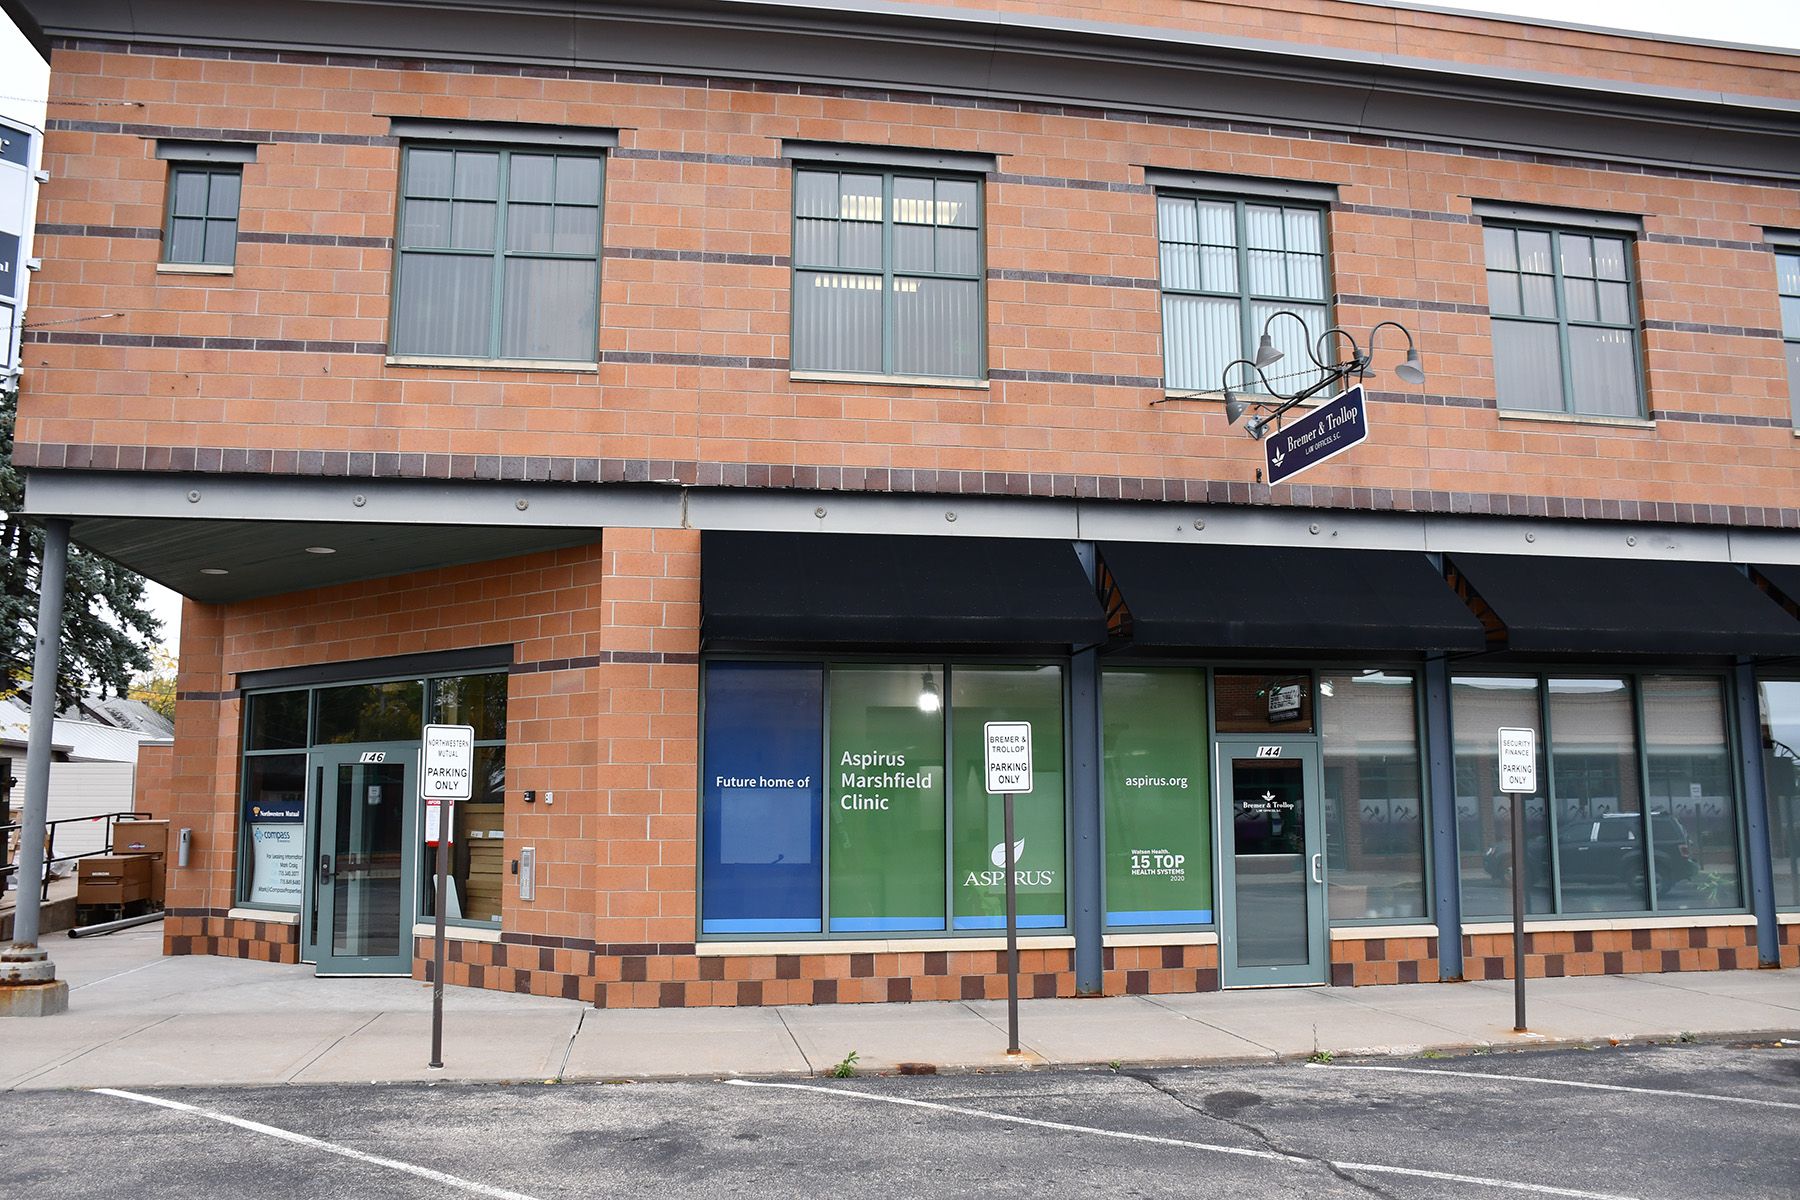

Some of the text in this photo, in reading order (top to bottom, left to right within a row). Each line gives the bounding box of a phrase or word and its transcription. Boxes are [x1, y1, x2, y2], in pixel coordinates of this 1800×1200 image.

[1287, 406, 1358, 452] Bremer & Trollop
[1304, 444, 1315, 455] LAW
[428, 739, 469, 748] NORTHWESTERN
[438, 749, 459, 758] MUTUAL
[991, 745, 1025, 753] TROLLOP
[1260, 747, 1280, 756] 144
[363, 753, 384, 762] 146
[840, 750, 905, 769] Aspirus
[990, 762, 1027, 772] PARKING
[1503, 764, 1532, 773] PARKING
[427, 767, 468, 778] PARKING
[716, 776, 810, 787] Future home of
[841, 772, 932, 788] Marshfield
[998, 775, 1020, 784] ONLY
[1125, 775, 1188, 789] aspirus.org
[1509, 775, 1526, 784] ONLY
[435, 780, 459, 790] ONLY
[840, 794, 889, 810] Clinic
[1272, 801, 1294, 810] Trollop
[264, 831, 291, 841] compass
[1131, 854, 1185, 869] 15 TOP
[963, 870, 1053, 886] ASPRUS
